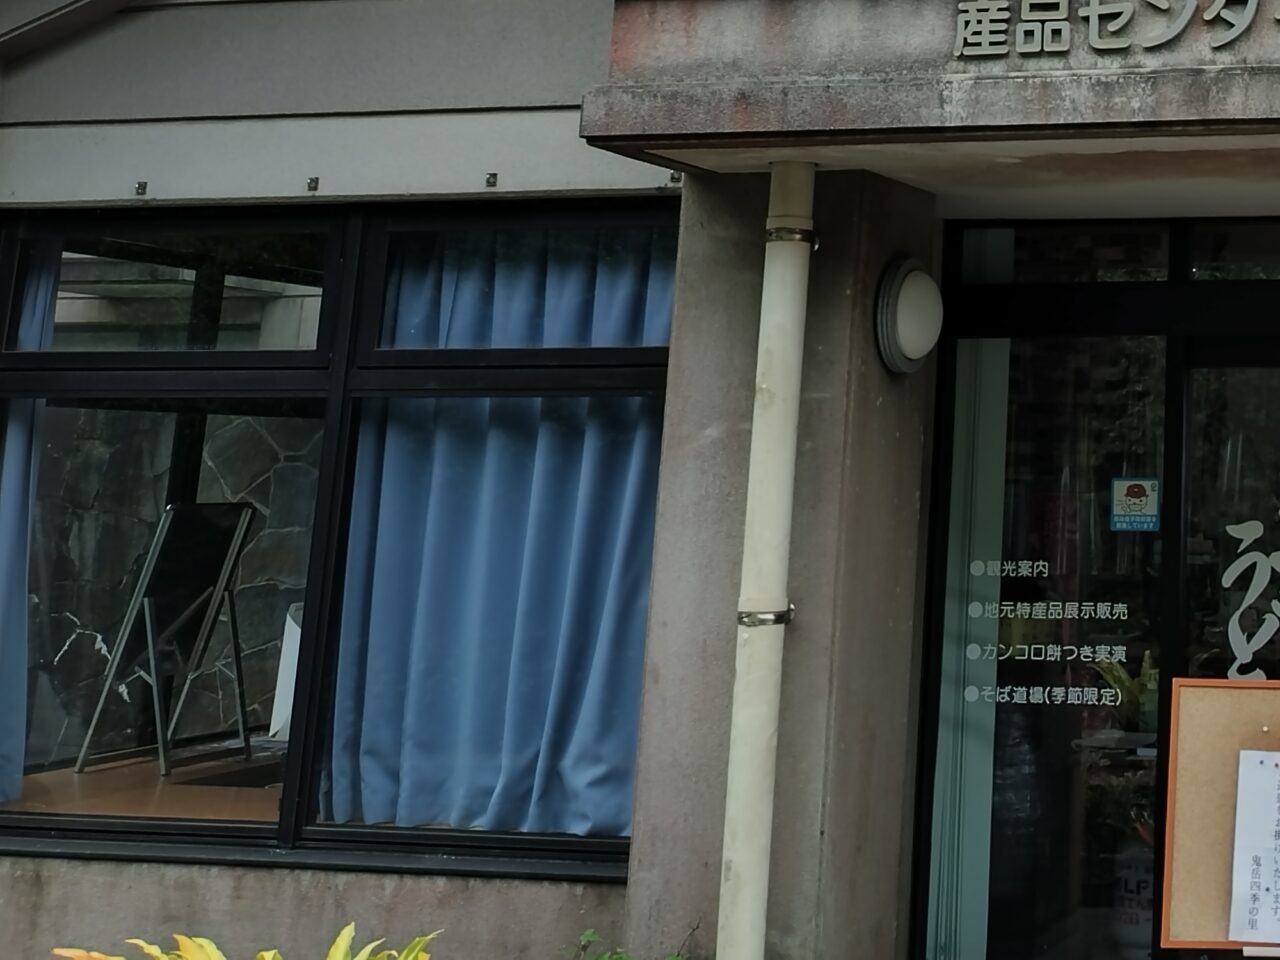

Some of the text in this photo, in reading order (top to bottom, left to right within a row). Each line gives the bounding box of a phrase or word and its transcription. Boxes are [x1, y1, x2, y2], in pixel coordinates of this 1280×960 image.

[987, 559, 1049, 578] 観光案内
[984, 601, 1128, 620] 地元特産品展示販売
[982, 643, 1127, 663] カンコロ餅つき実演
[980, 685, 1122, 706] そば道場(季節限定)
[1247, 854, 1263, 931] 鬼岳四季の里
